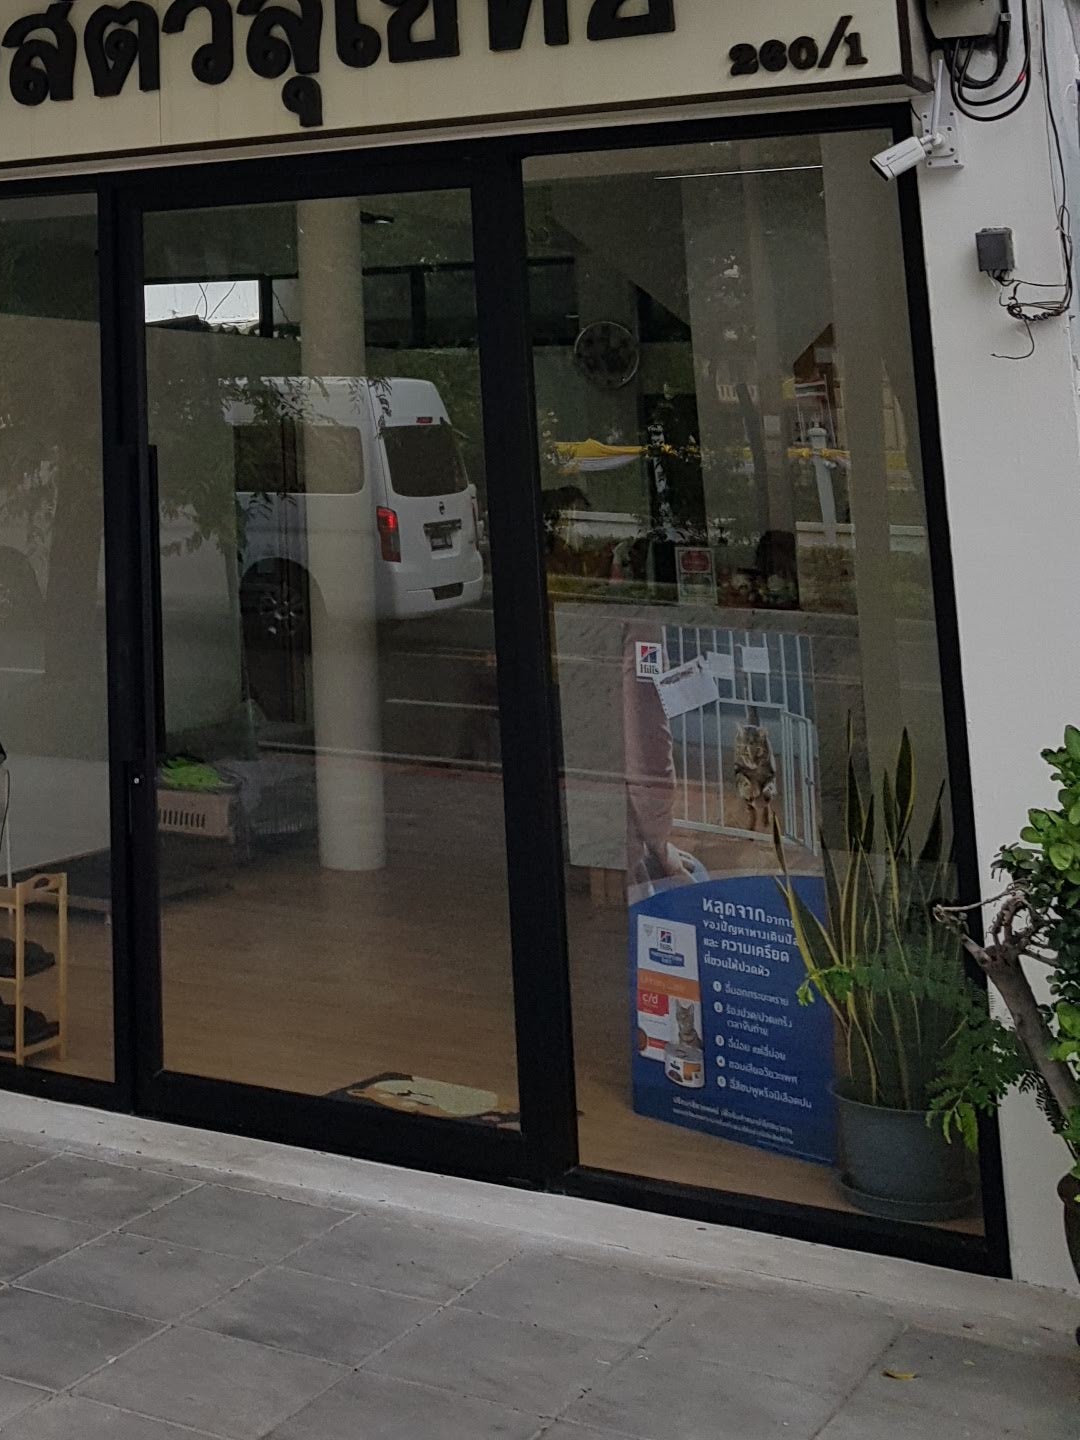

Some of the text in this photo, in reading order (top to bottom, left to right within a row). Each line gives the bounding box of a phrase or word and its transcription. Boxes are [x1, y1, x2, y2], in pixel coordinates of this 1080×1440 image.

[728, 15, 868, 76] 260/1
[640, 663, 659, 675] Hill's
[721, 939, 790, 963] ความเครียด
[642, 993, 658, 1005] c/d
